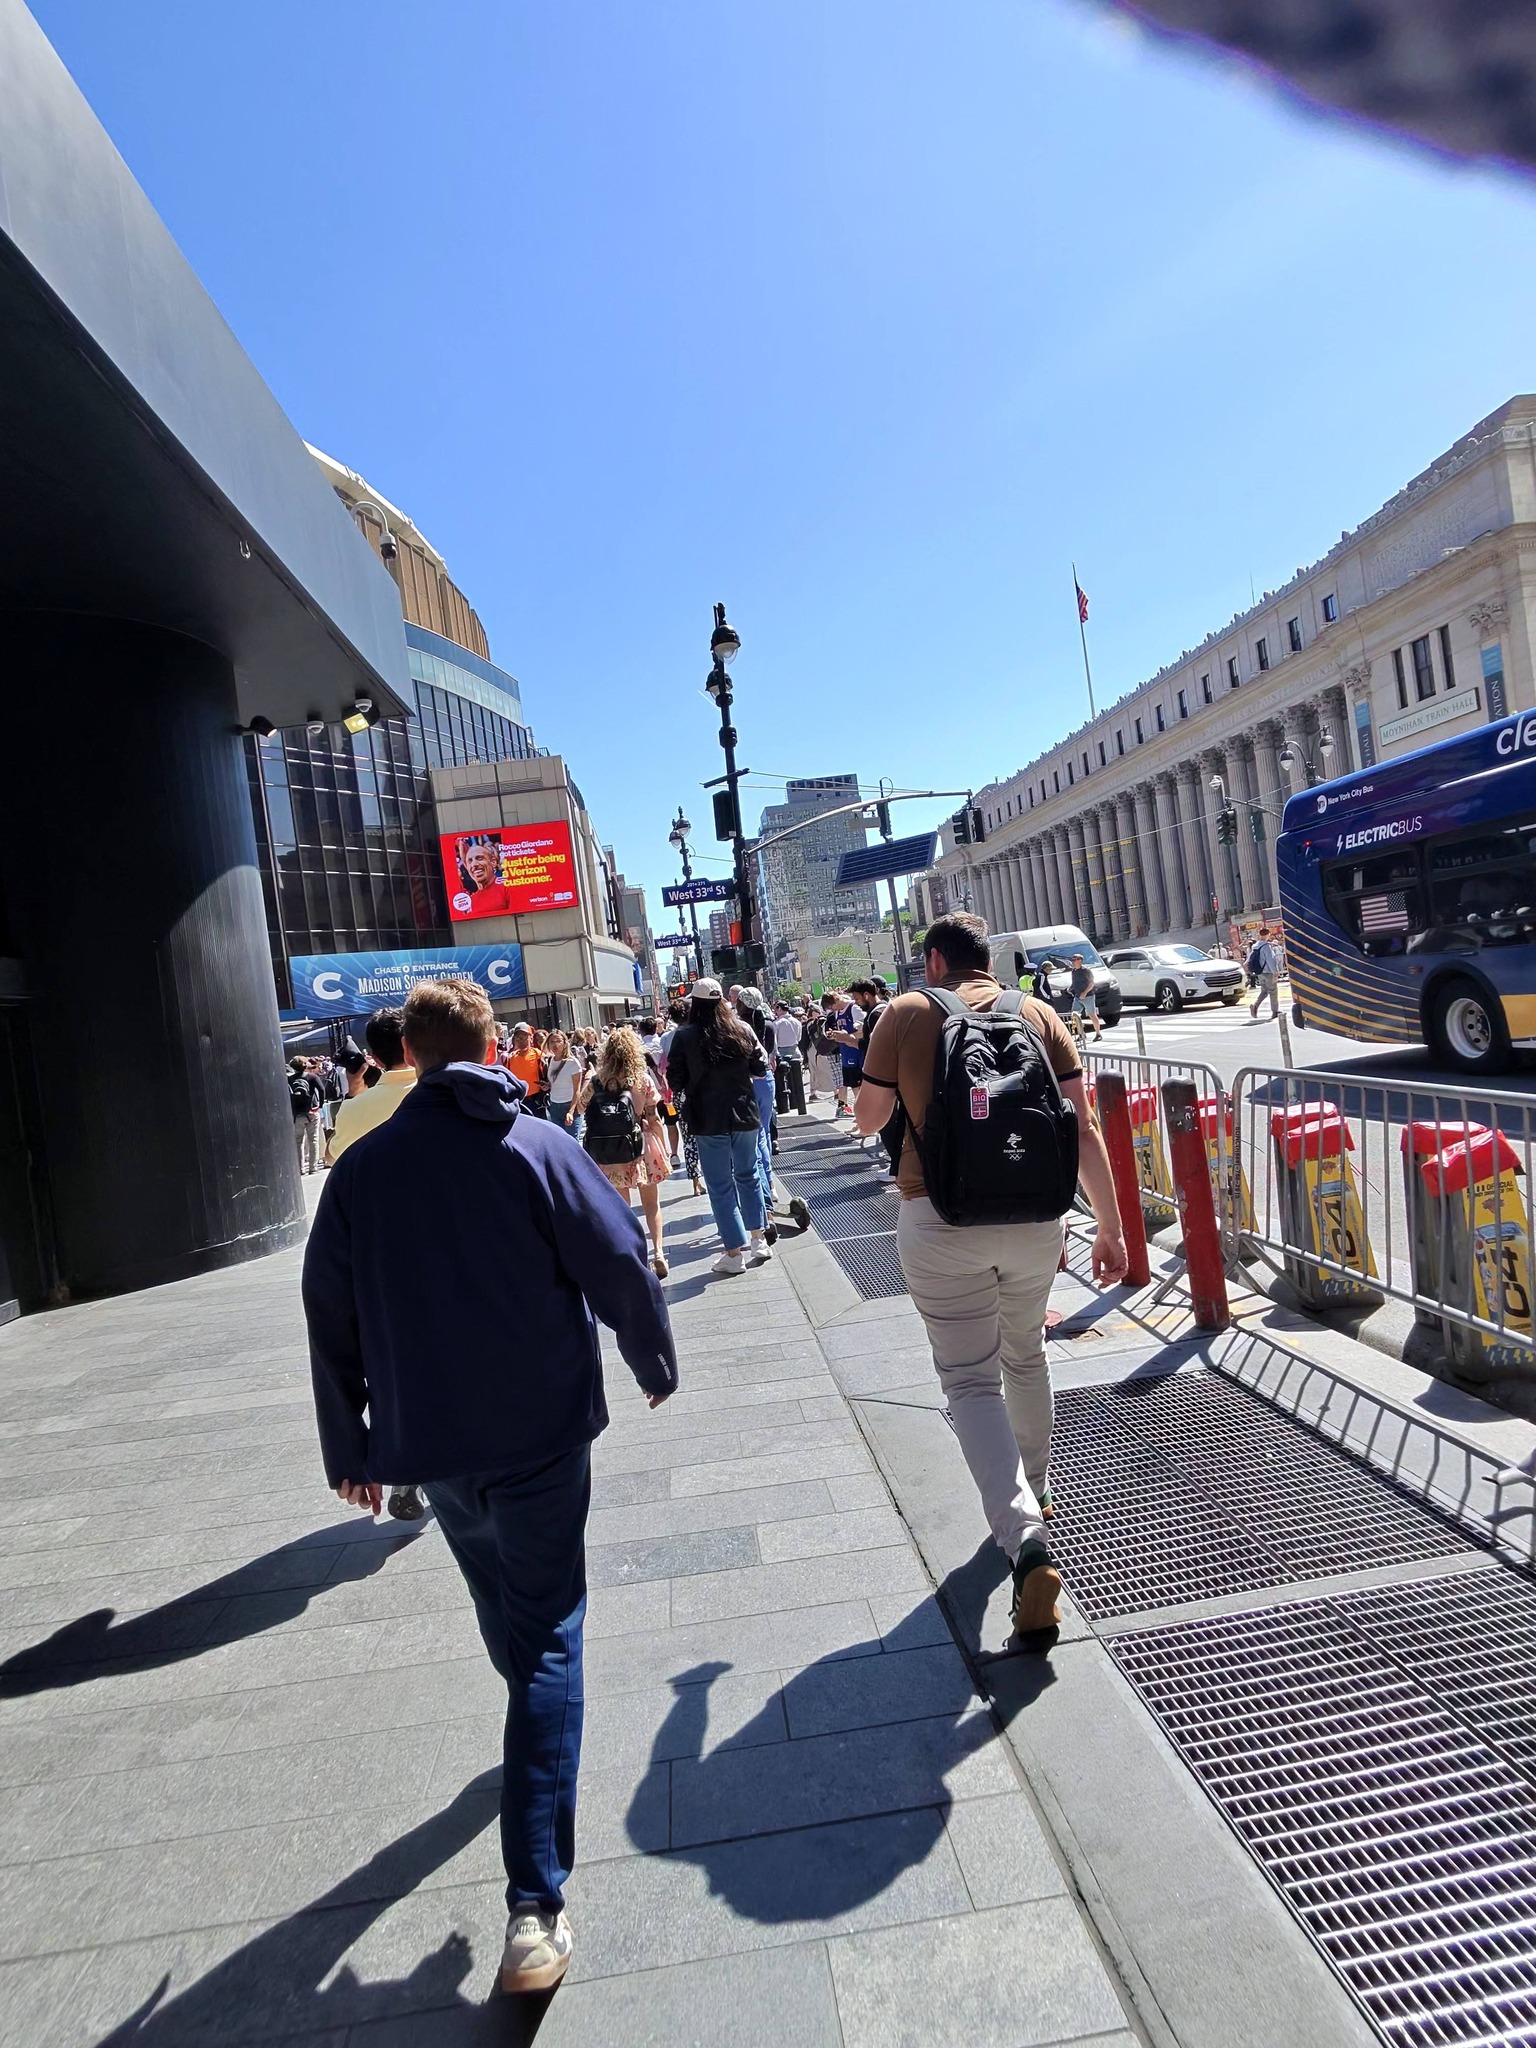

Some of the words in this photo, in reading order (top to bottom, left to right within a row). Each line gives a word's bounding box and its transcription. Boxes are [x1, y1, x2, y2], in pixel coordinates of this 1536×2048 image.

[1383, 717, 1423, 740] MOYNIHAN
[1425, 708, 1450, 724] TRAIN
[1452, 697, 1475, 713] HALL
[1328, 796, 1339, 805] New
[1339, 792, 1351, 802] York
[1351, 788, 1362, 798] City
[1362, 785, 1374, 794] Bus
[521, 839, 553, 847] Giordano
[502, 858, 522, 868] Just
[523, 856, 537, 865] for
[538, 853, 565, 863] being
[502, 870, 509, 878] a
[509, 866, 546, 876] Verizon
[504, 875, 552, 886] customer.
[669, 890, 693, 901] West
[695, 886, 713, 898] 33rd
[716, 885, 726, 895] St
[374, 967, 402, 975] CHASE
[412, 962, 459, 972] ENTRANCE
[488, 960, 512, 984] C
[313, 972, 344, 1000] C
[358, 976, 402, 994] MADISON
[1486, 1181, 1515, 1190] OFCIAL
